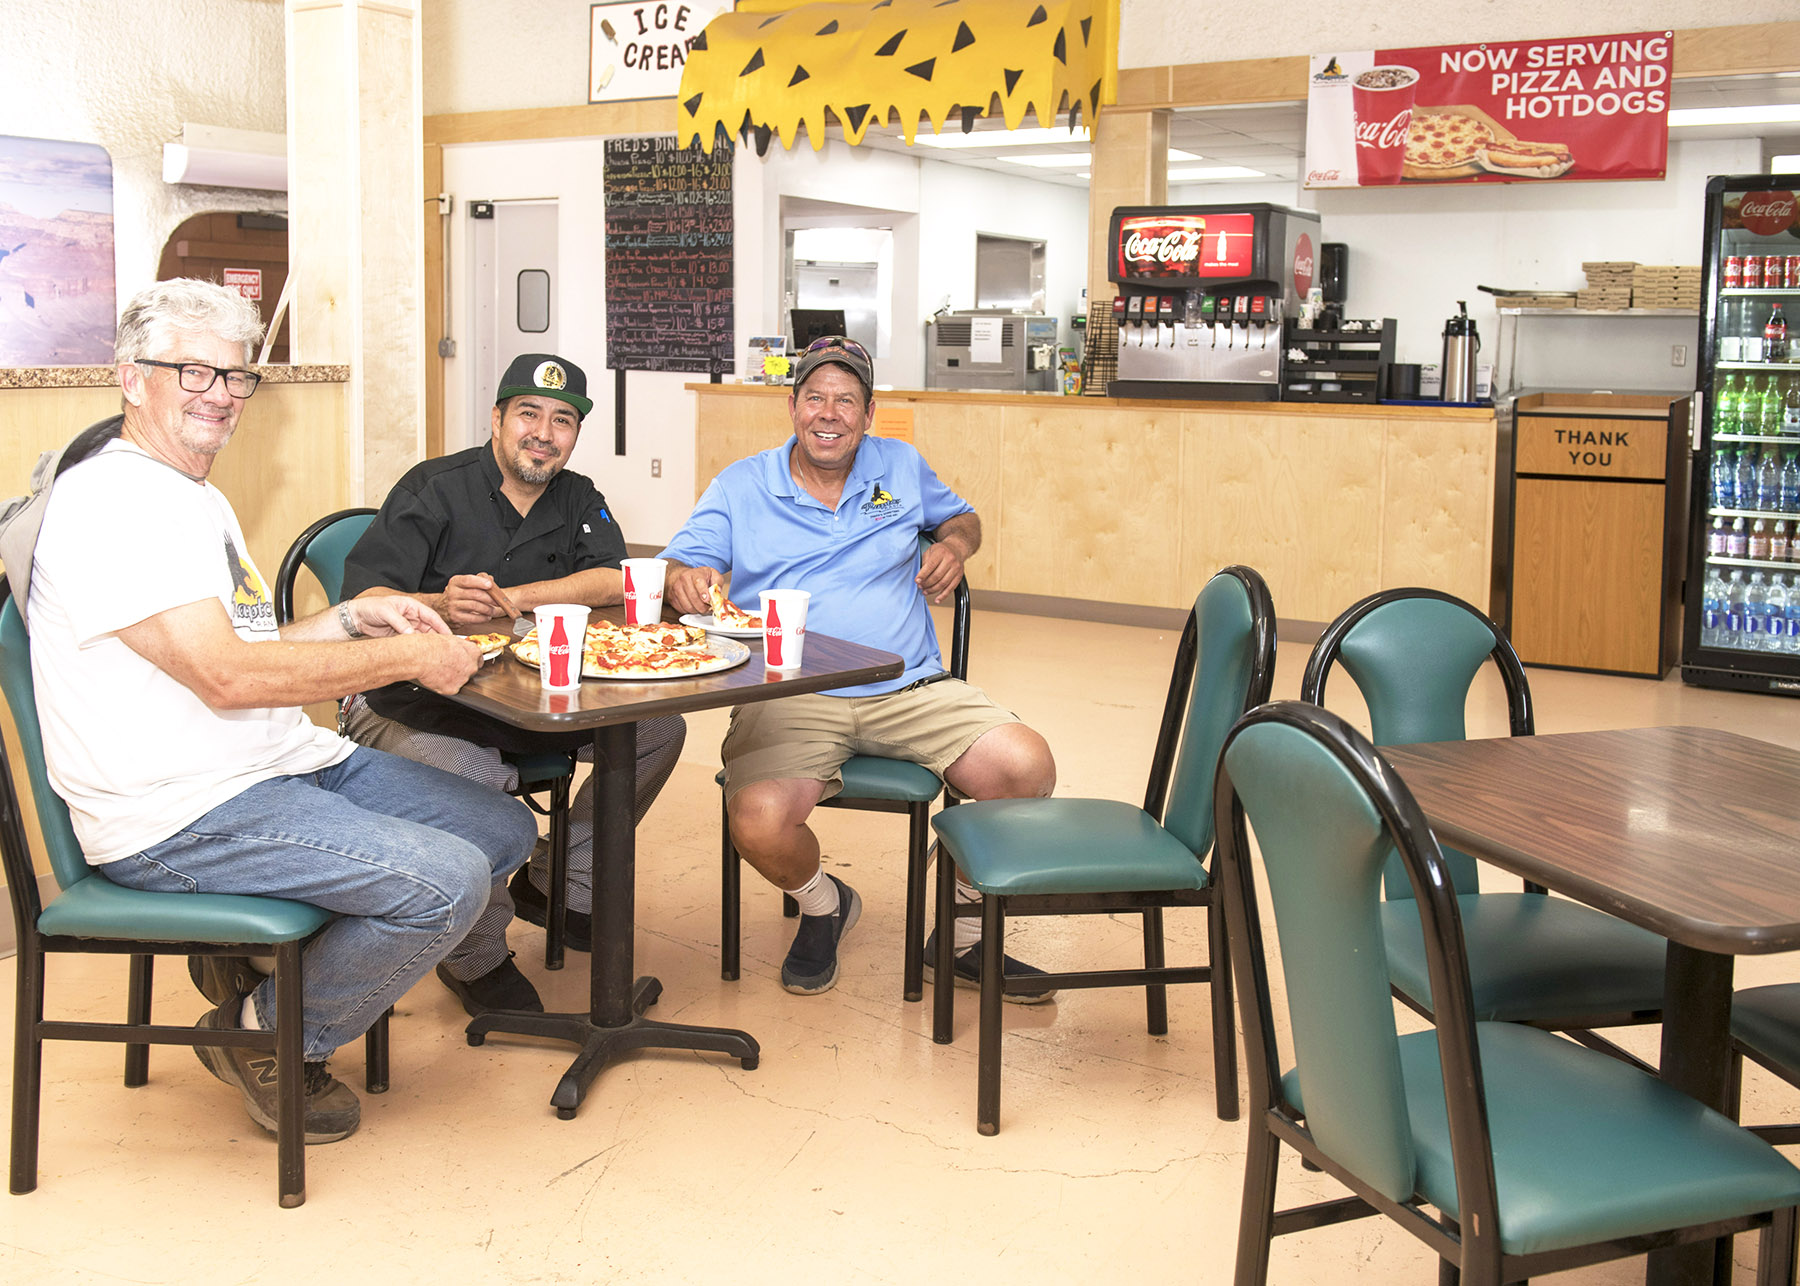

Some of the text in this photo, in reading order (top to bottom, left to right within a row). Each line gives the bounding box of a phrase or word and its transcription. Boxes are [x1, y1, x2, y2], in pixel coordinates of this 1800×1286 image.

[633, 4, 691, 35] ICE
[1440, 38, 1668, 73] NOW SERVING
[1491, 64, 1667, 95] PIZZA AND
[1506, 90, 1665, 119] HOTDOGS
[654, 136, 691, 151] DIN
[1741, 200, 1795, 217] Coca-Cola
[1125, 230, 1202, 262] Coca-Cola
[1554, 430, 1629, 447] THANK
[1569, 451, 1612, 466] YOU
